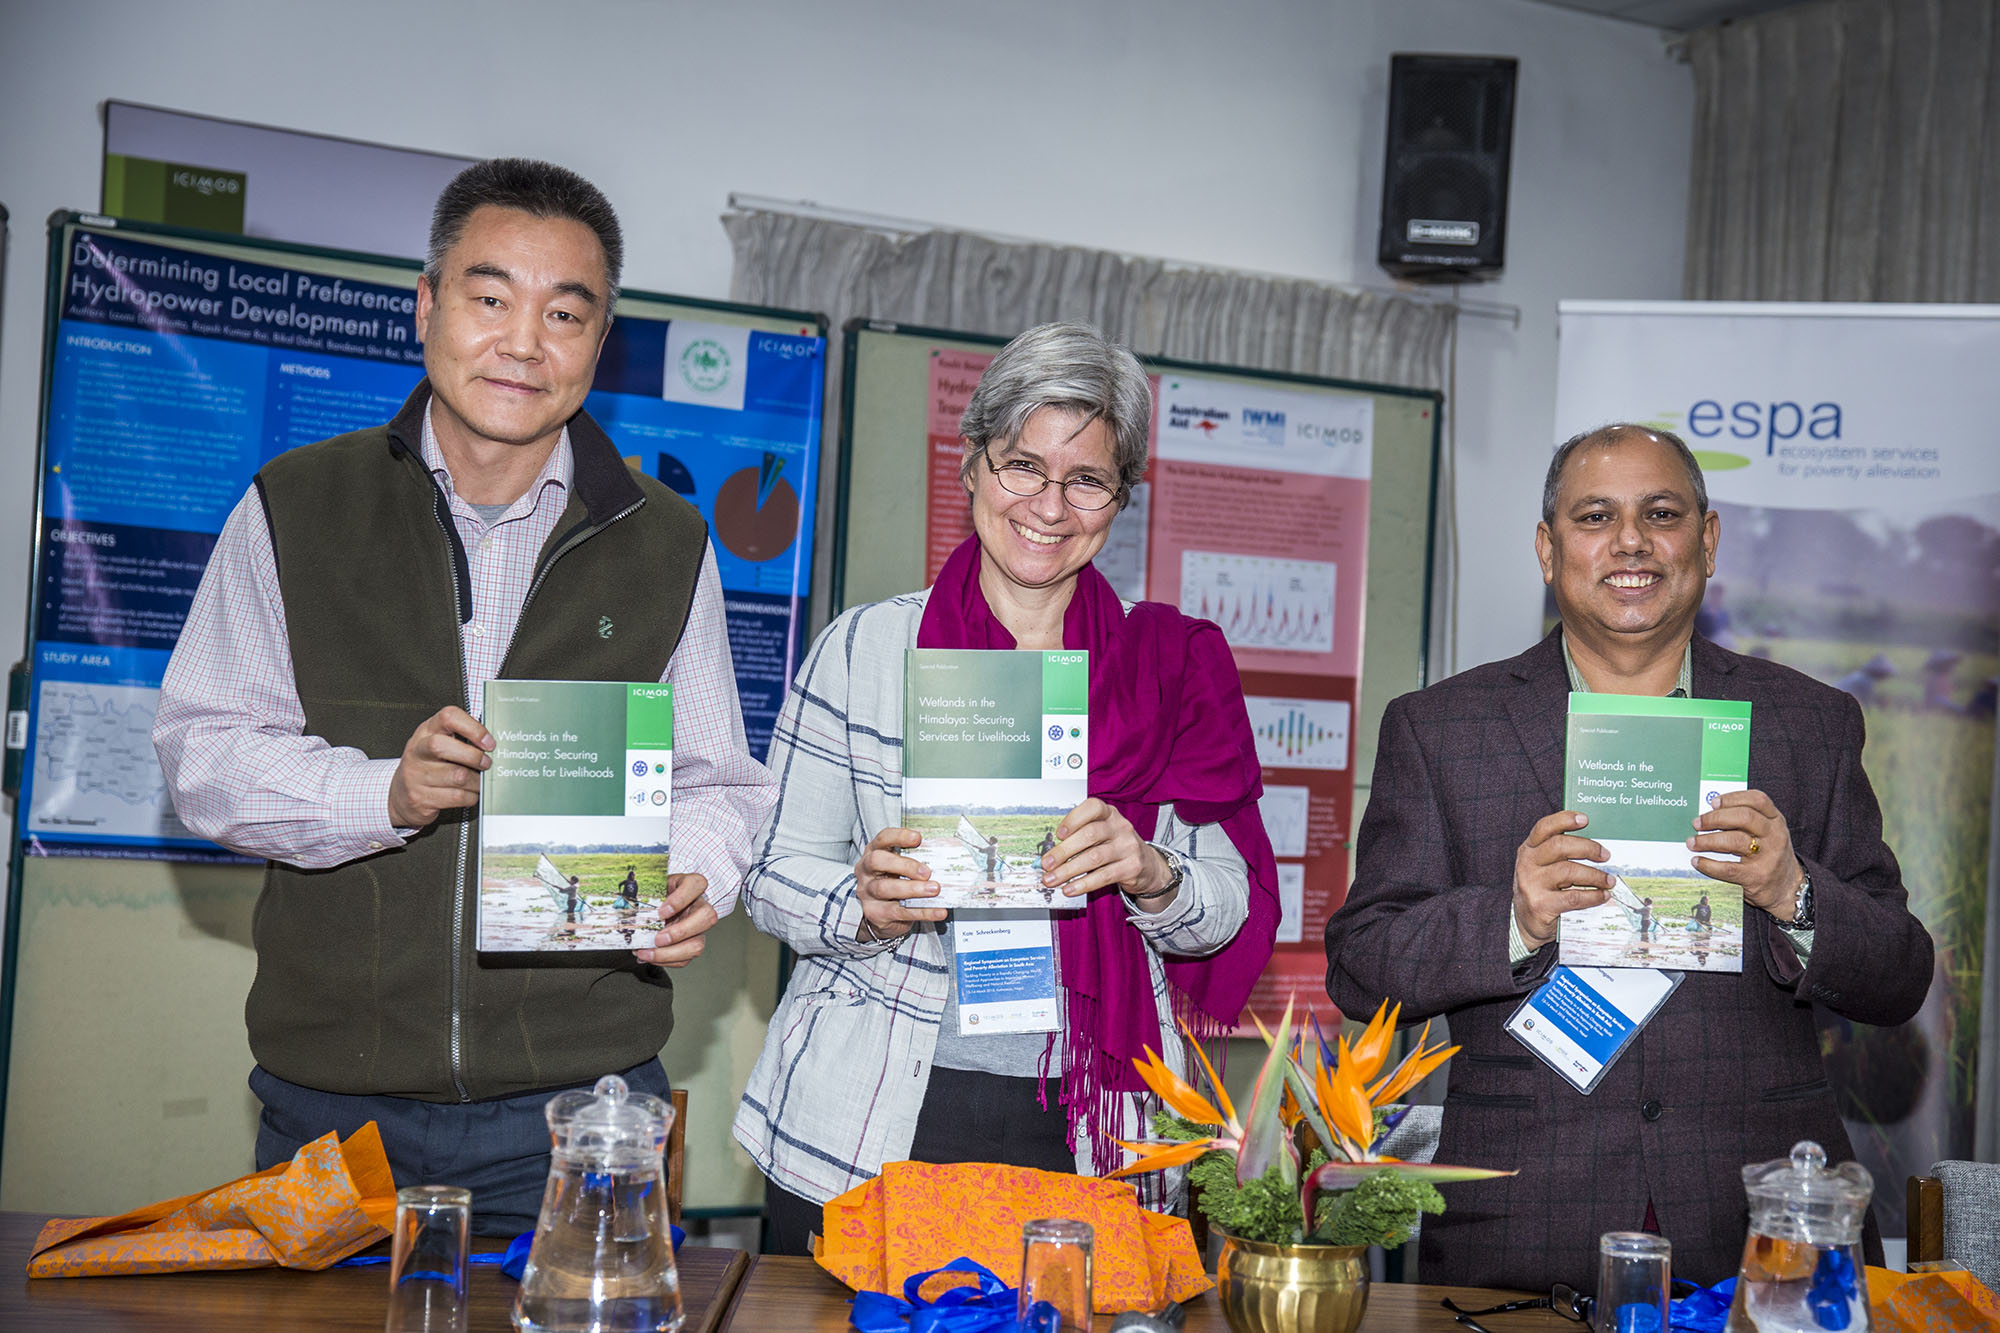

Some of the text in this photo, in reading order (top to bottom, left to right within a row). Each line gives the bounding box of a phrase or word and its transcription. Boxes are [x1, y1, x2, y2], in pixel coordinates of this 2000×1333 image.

[173, 171, 239, 195] ICIMOD
[74, 242, 219, 292] Determining
[228, 265, 289, 296] Local
[71, 272, 407, 342] Hydropower Development in
[67, 335, 152, 356] INTRODUCTION
[280, 362, 331, 380] METHODS
[1170, 404, 1230, 421] Australian
[1242, 408, 1286, 428] IWMI
[1169, 416, 1189, 430] Aid
[1688, 399, 1843, 457] espa
[1297, 423, 1364, 447] ICIMOD
[1780, 446, 1940, 463] ecosystem services
[1778, 463, 1940, 481] for poverty alleviation
[50, 528, 116, 547] OBJECTIVES
[725, 600, 791, 617] COMMENDATIONS
[42, 651, 111, 667] STUDY AREA
[1048, 655, 1083, 665] ICIMOD
[633, 688, 669, 699] ICIMOD
[919, 697, 996, 708] Wetlands in the
[919, 714, 1015, 728] Himalaya: Securing
[1708, 722, 1744, 733] ICIMOD
[497, 731, 578, 742] Wetlands in the
[919, 731, 1031, 743] Services for Livelihoods
[497, 749, 598, 762] Himalaya: Securing
[497, 765, 614, 779] Services for Livelihoods
[1578, 759, 1654, 773] Wetlands in the
[1577, 776, 1673, 792] Himalaya: Securing
[1577, 792, 1688, 807] Services for Livelihoods
